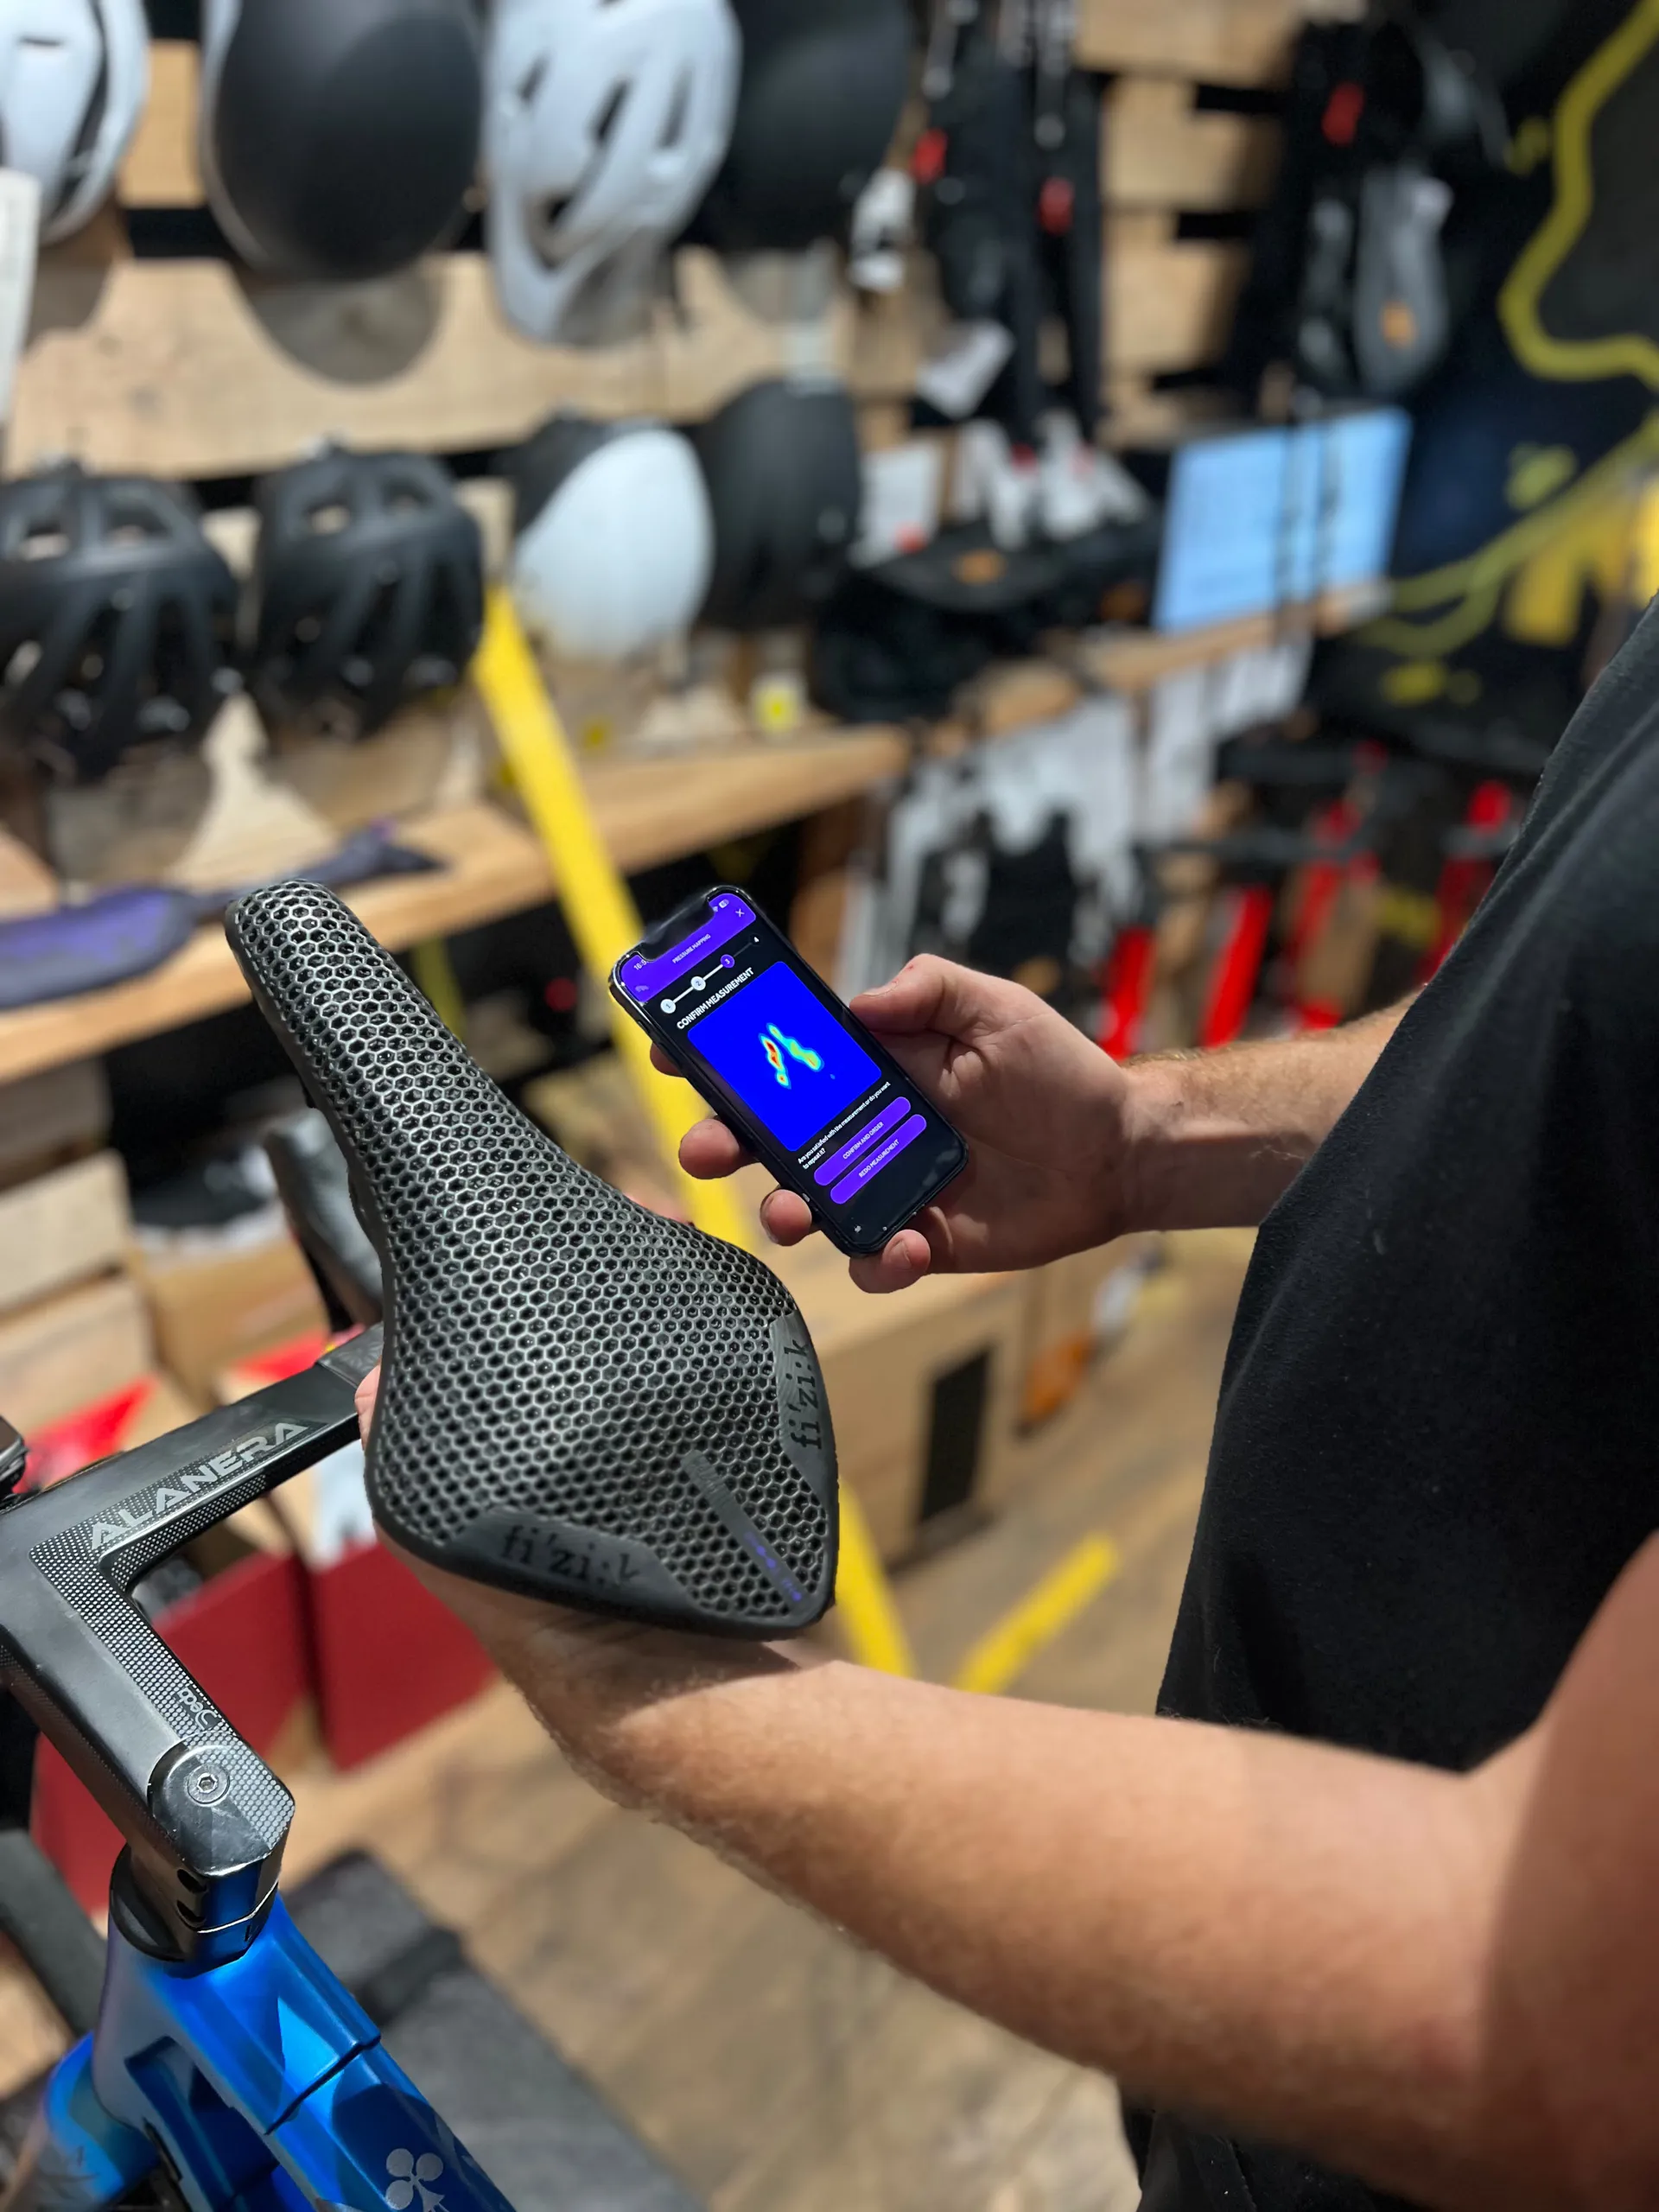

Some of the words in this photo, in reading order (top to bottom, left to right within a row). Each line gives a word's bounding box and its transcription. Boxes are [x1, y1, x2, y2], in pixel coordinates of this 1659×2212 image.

[671, 946, 693, 963] PRESSURE
[691, 933, 711, 949] MAPPING
[677, 1003, 709, 1029] CONFIRM
[705, 967, 753, 1007] MEASUREMENT
[812, 1135, 829, 1152] satisfied
[841, 1103, 866, 1126] measurement
[880, 1081, 891, 1091] want
[808, 1152, 821, 1166] repeat
[842, 1141, 862, 1159] CONFIRM
[861, 1133, 870, 1144] AND
[868, 1122, 884, 1136] ORDER
[859, 1165, 871, 1178] REDO
[869, 1139, 899, 1167] MEASUREMENT
[90, 1421, 309, 1550] ALANERA
